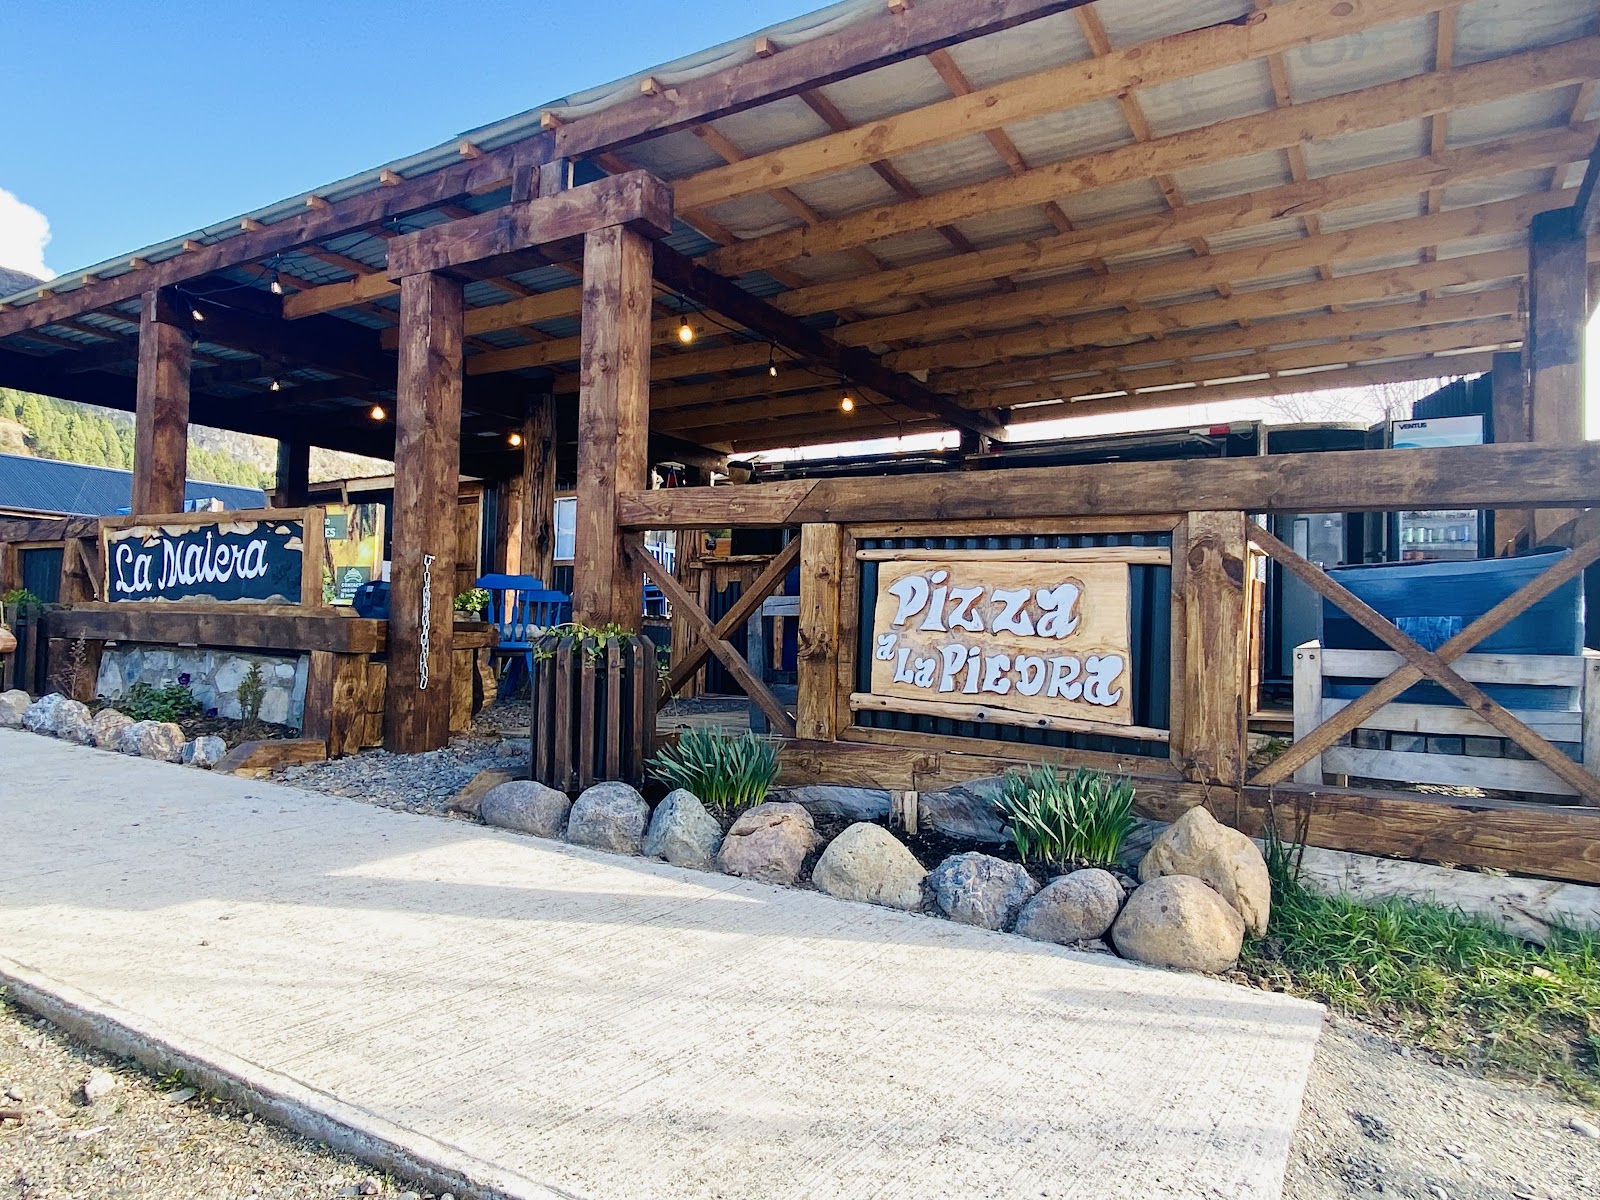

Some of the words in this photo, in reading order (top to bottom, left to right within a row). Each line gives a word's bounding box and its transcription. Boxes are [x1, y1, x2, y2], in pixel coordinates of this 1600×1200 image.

[1398, 422, 1427, 430] VENTUS
[116, 544, 153, 592] La
[158, 531, 269, 590] Matera
[888, 570, 1081, 639] Pizza
